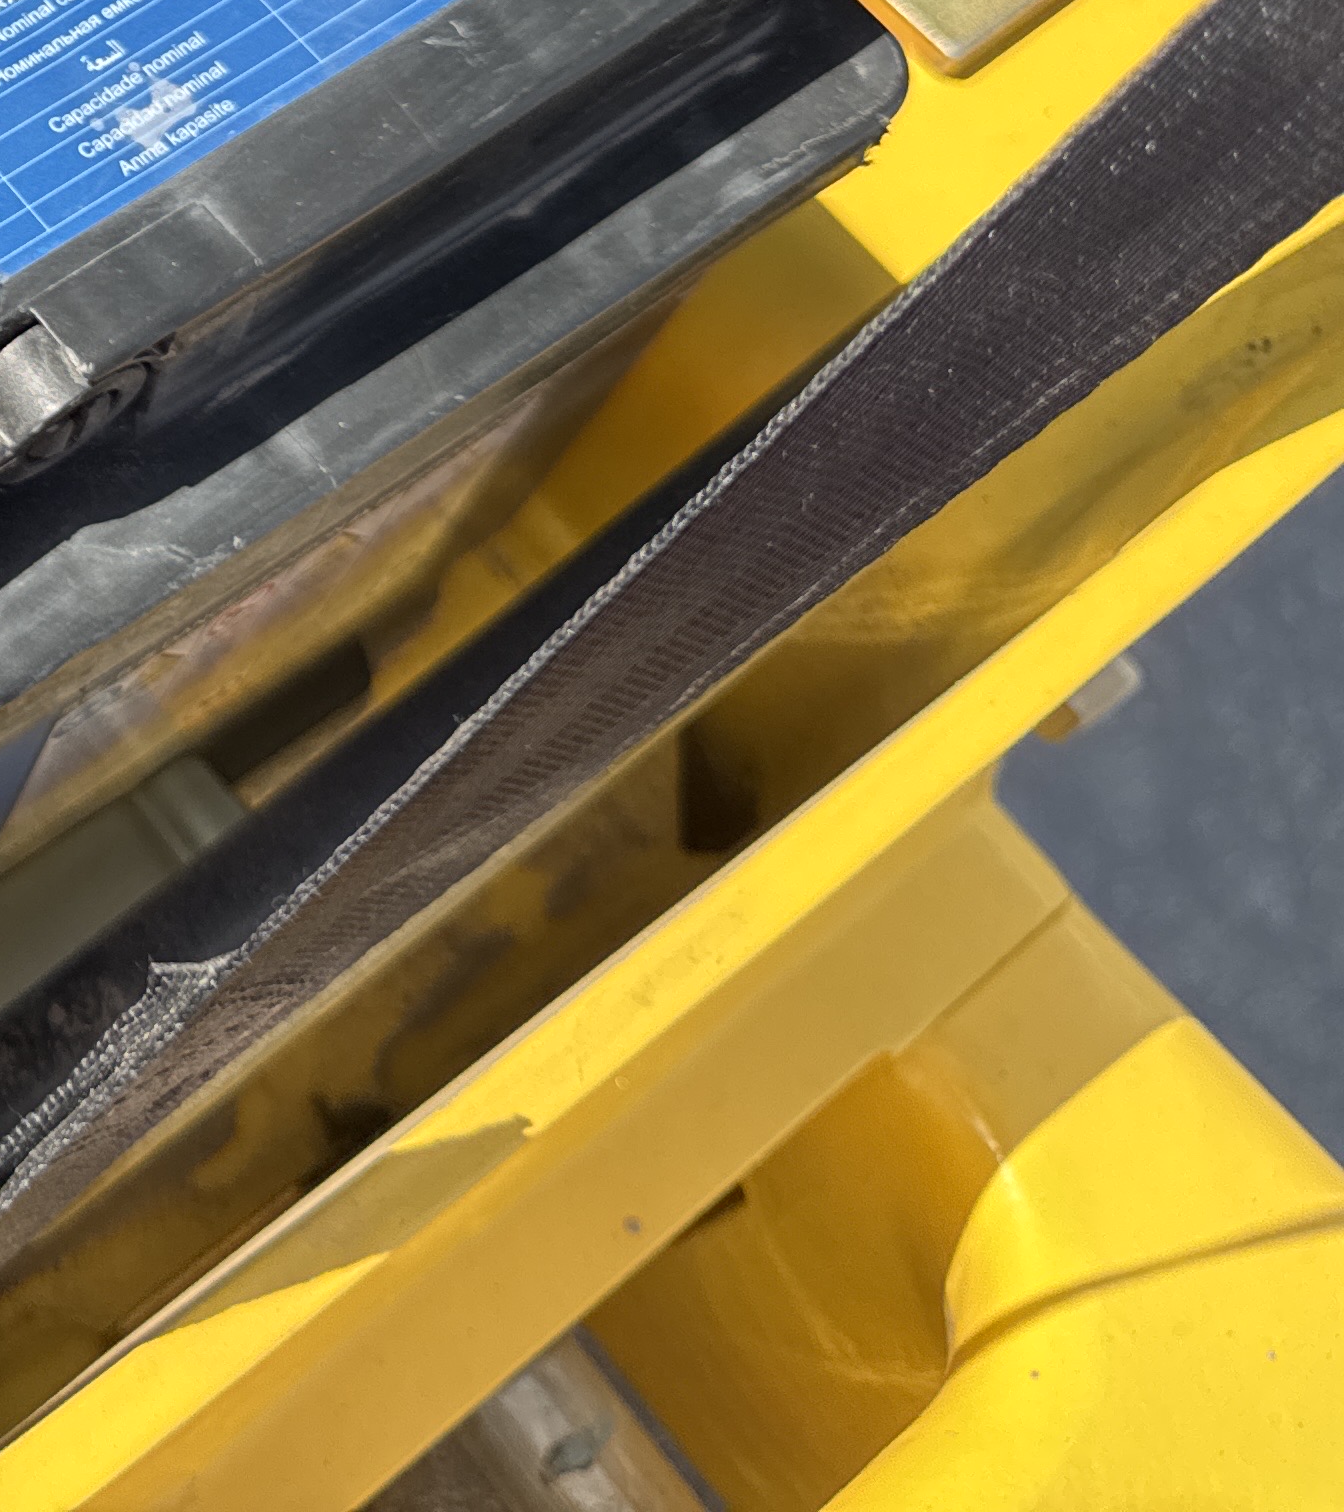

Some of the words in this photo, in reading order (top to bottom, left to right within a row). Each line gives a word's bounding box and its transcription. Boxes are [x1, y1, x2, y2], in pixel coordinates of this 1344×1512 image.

[48, 72, 144, 133] Capacidade
[142, 31, 207, 77] nominal
[77, 101, 163, 158] Capacidad
[161, 61, 229, 112] nominal
[118, 142, 170, 178] Anma
